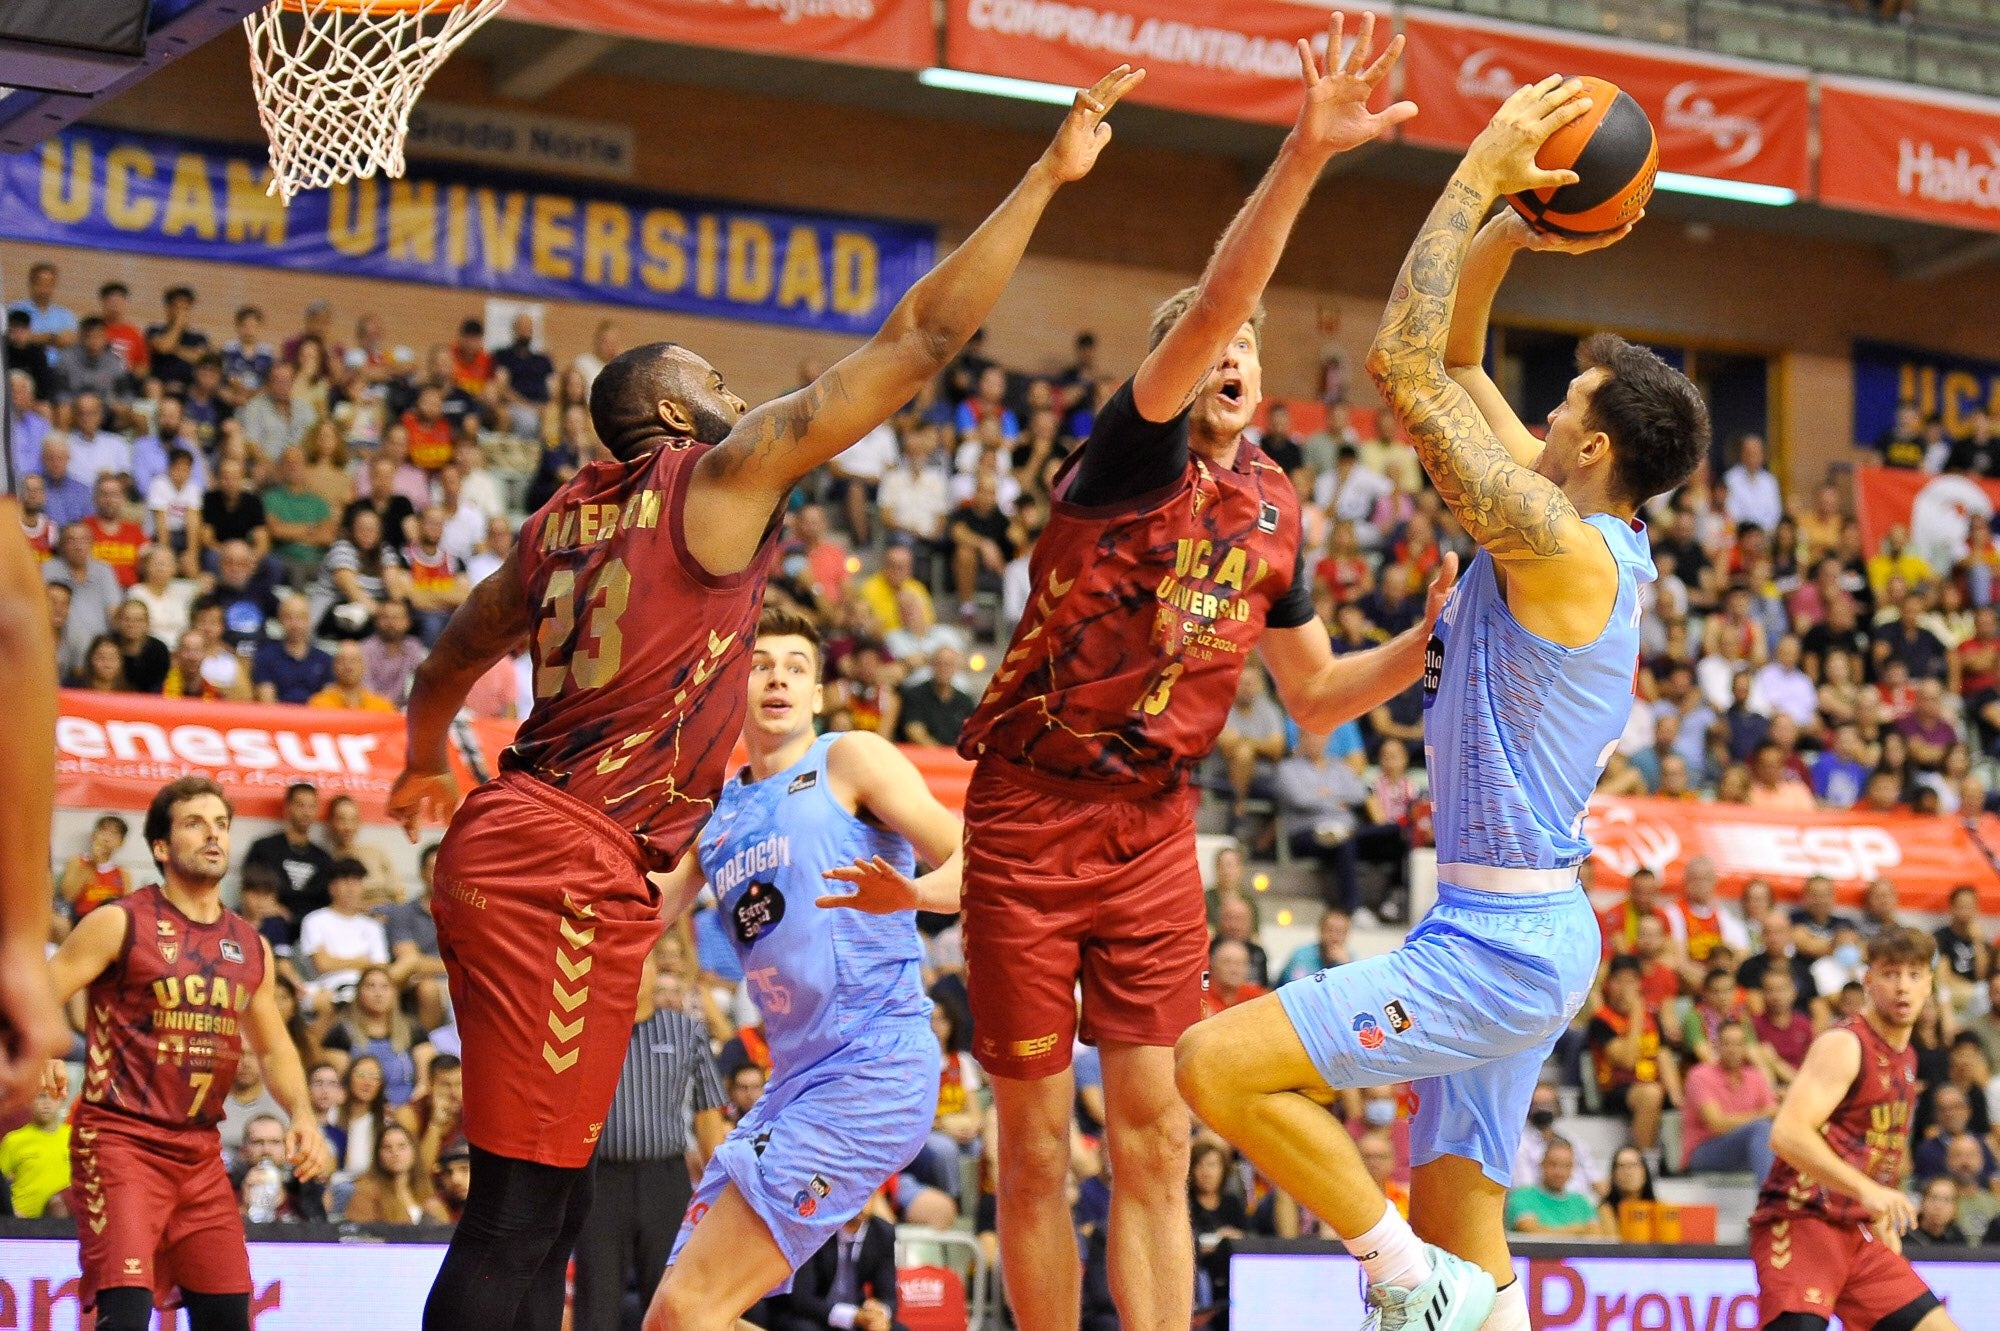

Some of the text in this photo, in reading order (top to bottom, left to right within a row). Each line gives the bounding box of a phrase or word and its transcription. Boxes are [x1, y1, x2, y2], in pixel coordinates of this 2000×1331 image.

[40, 137, 879, 316] UCAM UNIVERSIDAD
[536, 557, 632, 699] 23
[1750, 823, 1903, 882] ESP
[1385, 1005, 1402, 1028] acb
[1018, 1032, 1059, 1057] ESP
[186, 1072, 214, 1118] 7
